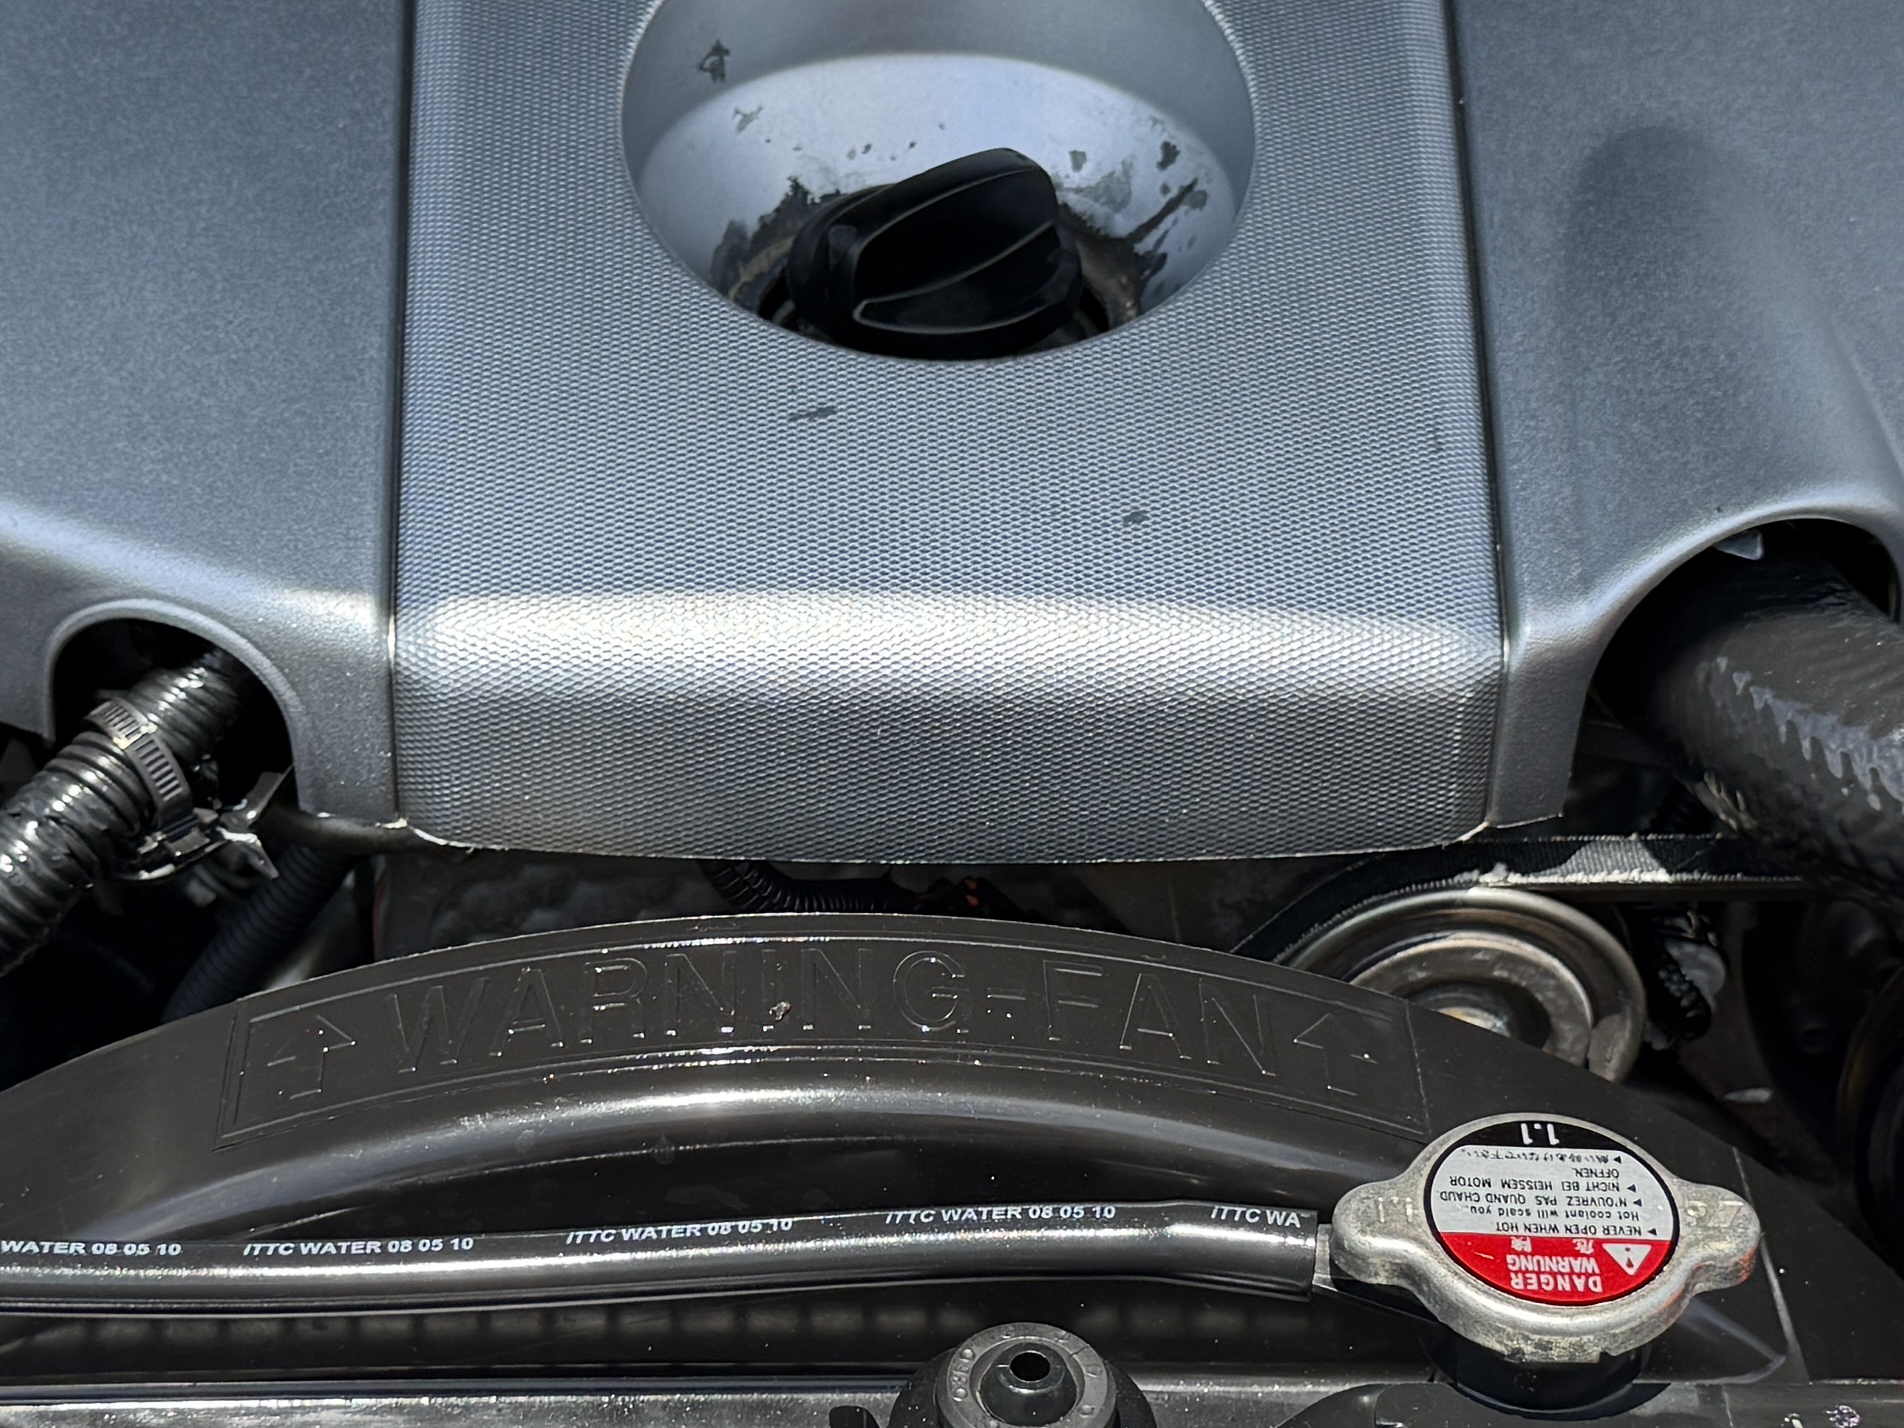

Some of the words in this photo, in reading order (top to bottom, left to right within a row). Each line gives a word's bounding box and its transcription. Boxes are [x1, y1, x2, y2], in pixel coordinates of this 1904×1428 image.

[1520, 1122, 1560, 1145] 1.1
[1449, 1176, 1492, 1189] MOTOR
[1500, 1179, 1552, 1191] HEISSEM
[1562, 1181, 1579, 1191] BEI
[1586, 1181, 1620, 1192] NICHT
[1485, 1192, 1526, 1205] QUAND
[1535, 1195, 1557, 1206] PAS
[885, 1209, 936, 1225] ITTC
[941, 1207, 1023, 1223] WATER
[1027, 1206, 1053, 1220] 08
[1059, 1206, 1085, 1220] 05
[1092, 1206, 1117, 1220] 10
[1210, 1204, 1262, 1224] ITTC
[1265, 1209, 1312, 1229] WA
[1498, 1207, 1531, 1218] scald
[1537, 1209, 1558, 1219] will
[1565, 1209, 1611, 1220] coolant
[1617, 1210, 1639, 1221] Hot
[566, 1228, 617, 1245] ITTC
[621, 1223, 702, 1241] WATER
[707, 1221, 733, 1236] 08
[737, 1220, 763, 1234] 05
[768, 1218, 794, 1232] 10
[1495, 1222, 1518, 1232] HOT
[1524, 1223, 1559, 1233] WHEN
[1564, 1224, 1596, 1235] OPEN
[1602, 1225, 1641, 1236] NEVER
[1, 1239, 86, 1256] WATER
[92, 1243, 121, 1256] 08
[123, 1243, 150, 1256] 05
[156, 1243, 183, 1256] 10
[243, 1242, 294, 1256] ITTC
[300, 1240, 382, 1255] WATER
[387, 1240, 413, 1253] 08
[418, 1239, 444, 1252] 05
[449, 1237, 474, 1250] 10
[1506, 1254, 1600, 1273] WARNUNG
[1510, 1272, 1602, 1293] DANGER
